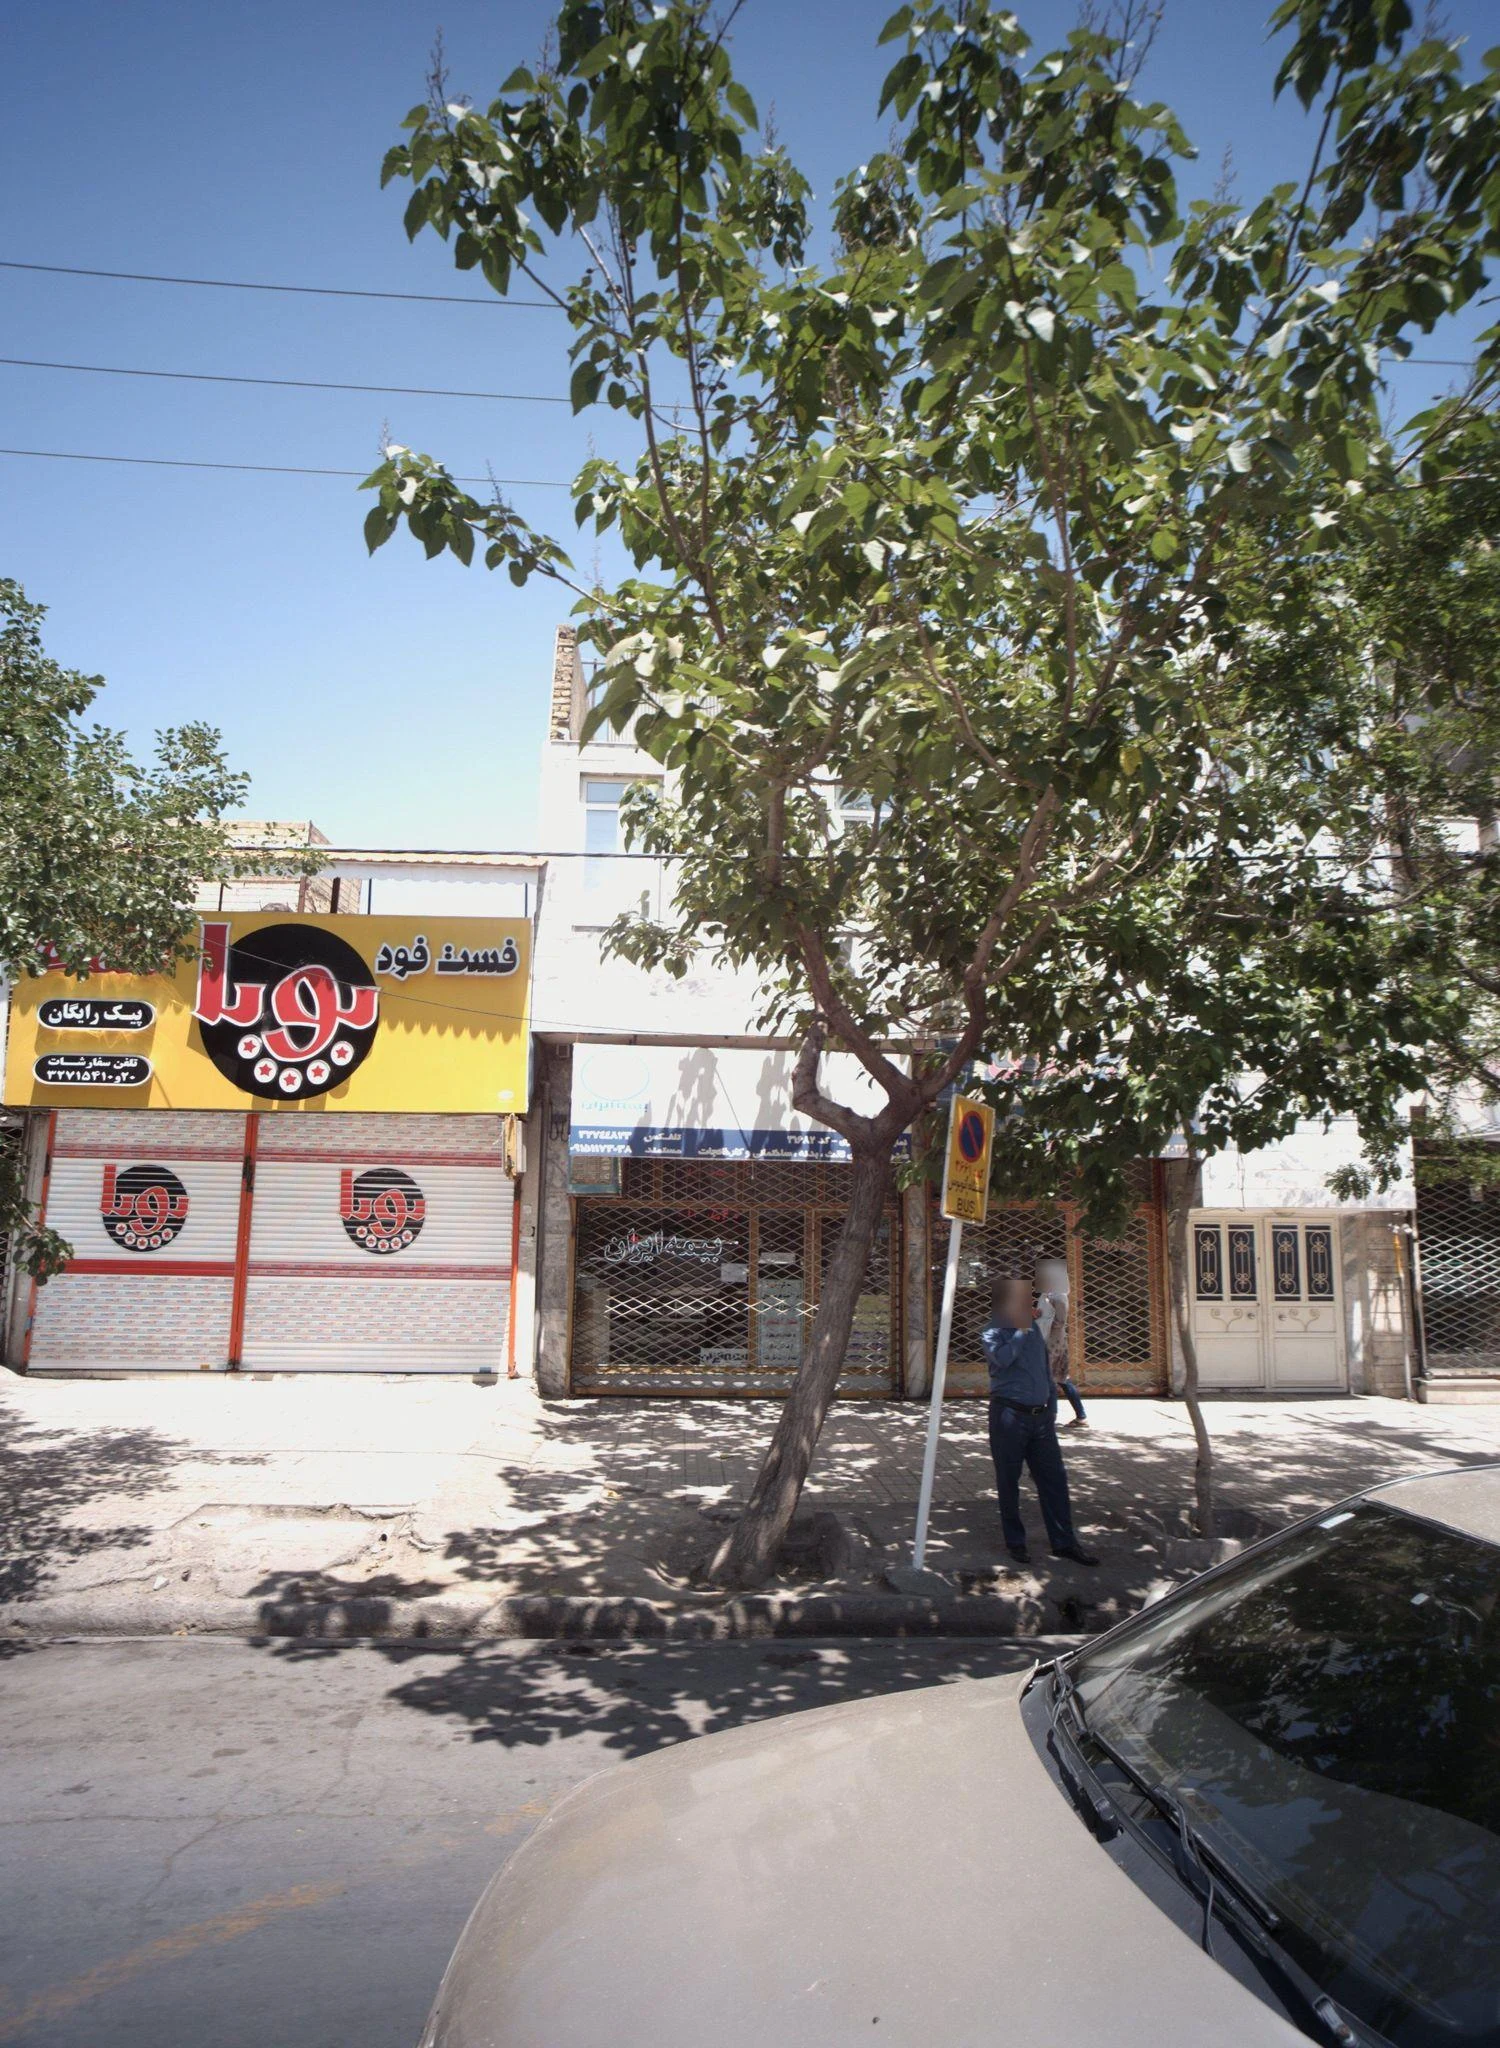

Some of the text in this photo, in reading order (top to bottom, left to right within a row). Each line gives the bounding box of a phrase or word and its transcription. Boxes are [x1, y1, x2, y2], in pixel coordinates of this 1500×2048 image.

[375, 933, 520, 981] فست فود
[48, 1002, 143, 1027] پیک رایگان
[47, 1056, 139, 1069] تلفن سفارشات
[957, 1198, 976, 1214] BUS
[603, 1227, 723, 1263] بیمه ایران
